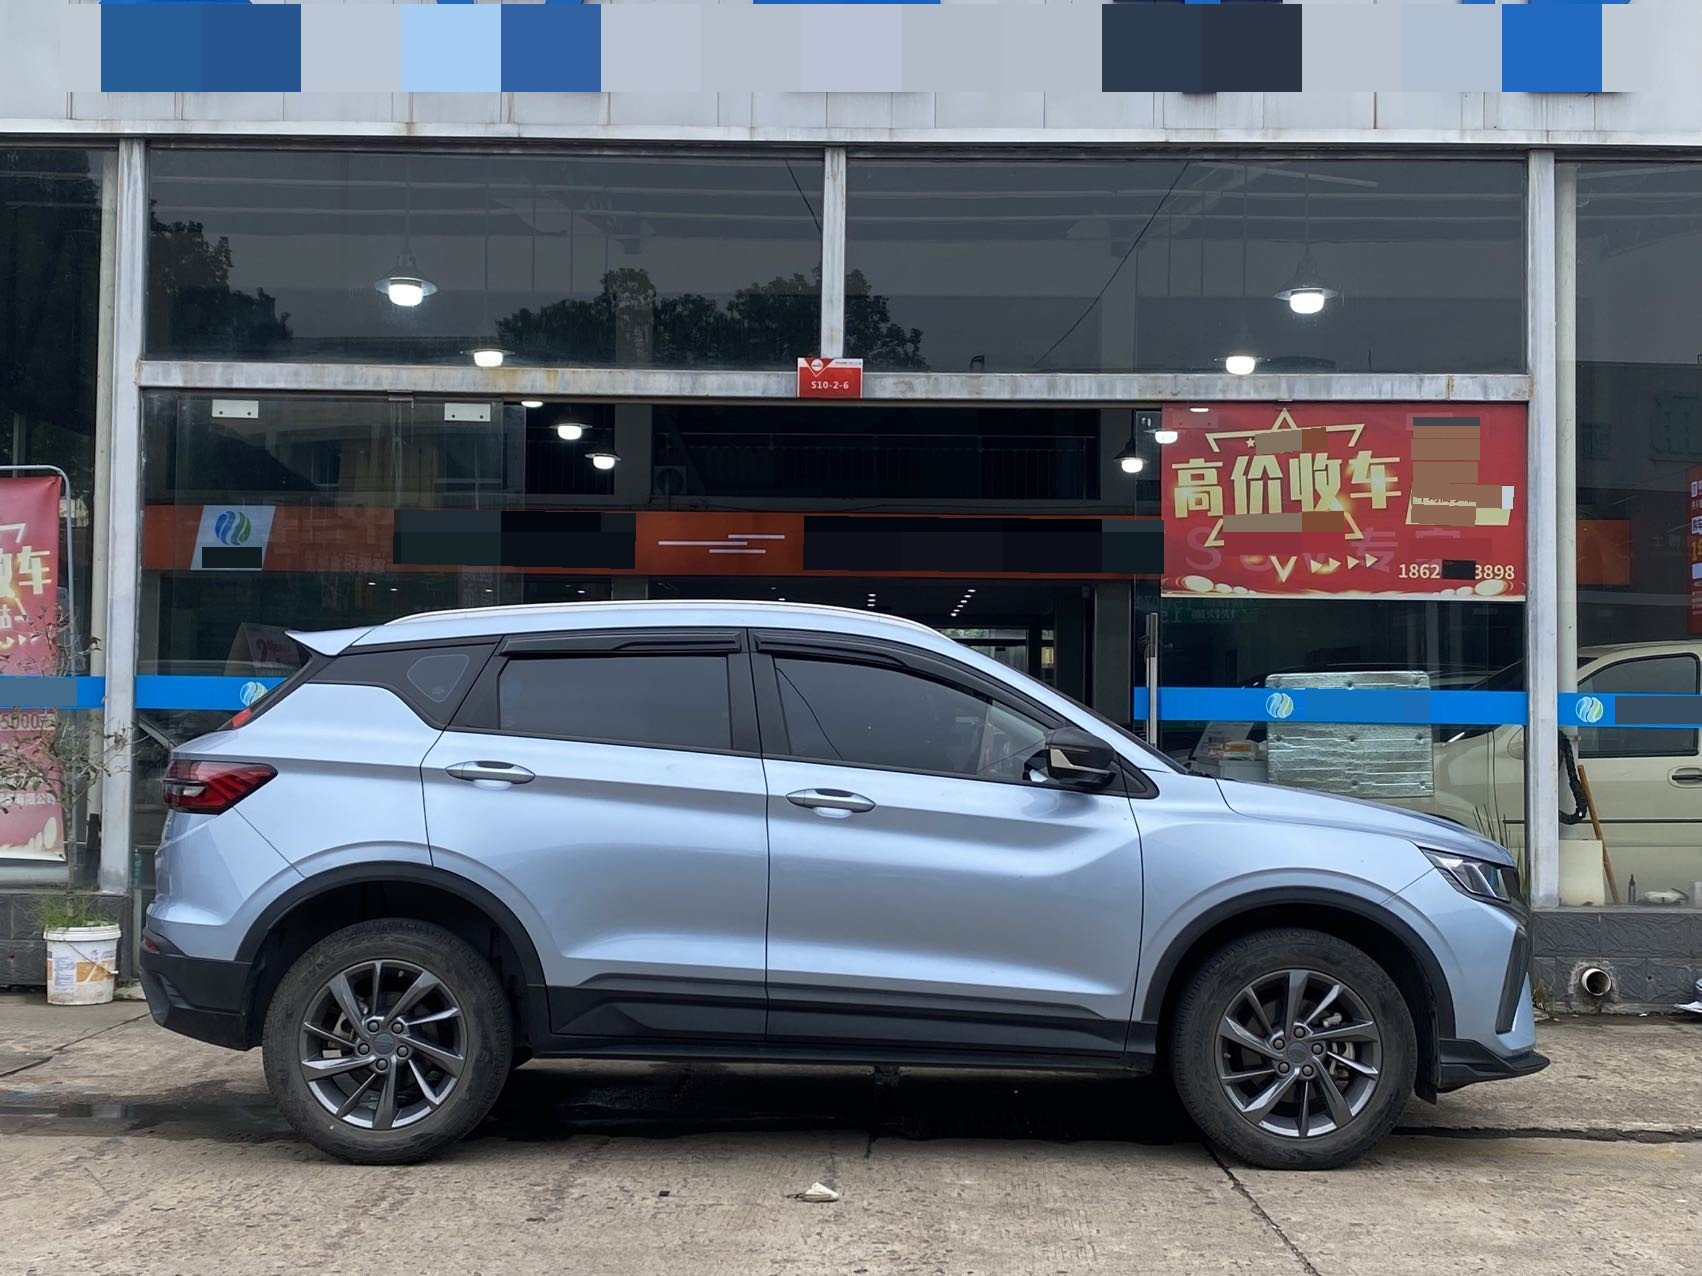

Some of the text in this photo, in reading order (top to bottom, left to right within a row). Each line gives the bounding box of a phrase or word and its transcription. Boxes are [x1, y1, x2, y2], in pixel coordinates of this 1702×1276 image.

[811, 381, 849, 390] S10-2-6
[1172, 450, 1401, 518] 高价收车
[1399, 563, 1515, 579] 18623898
